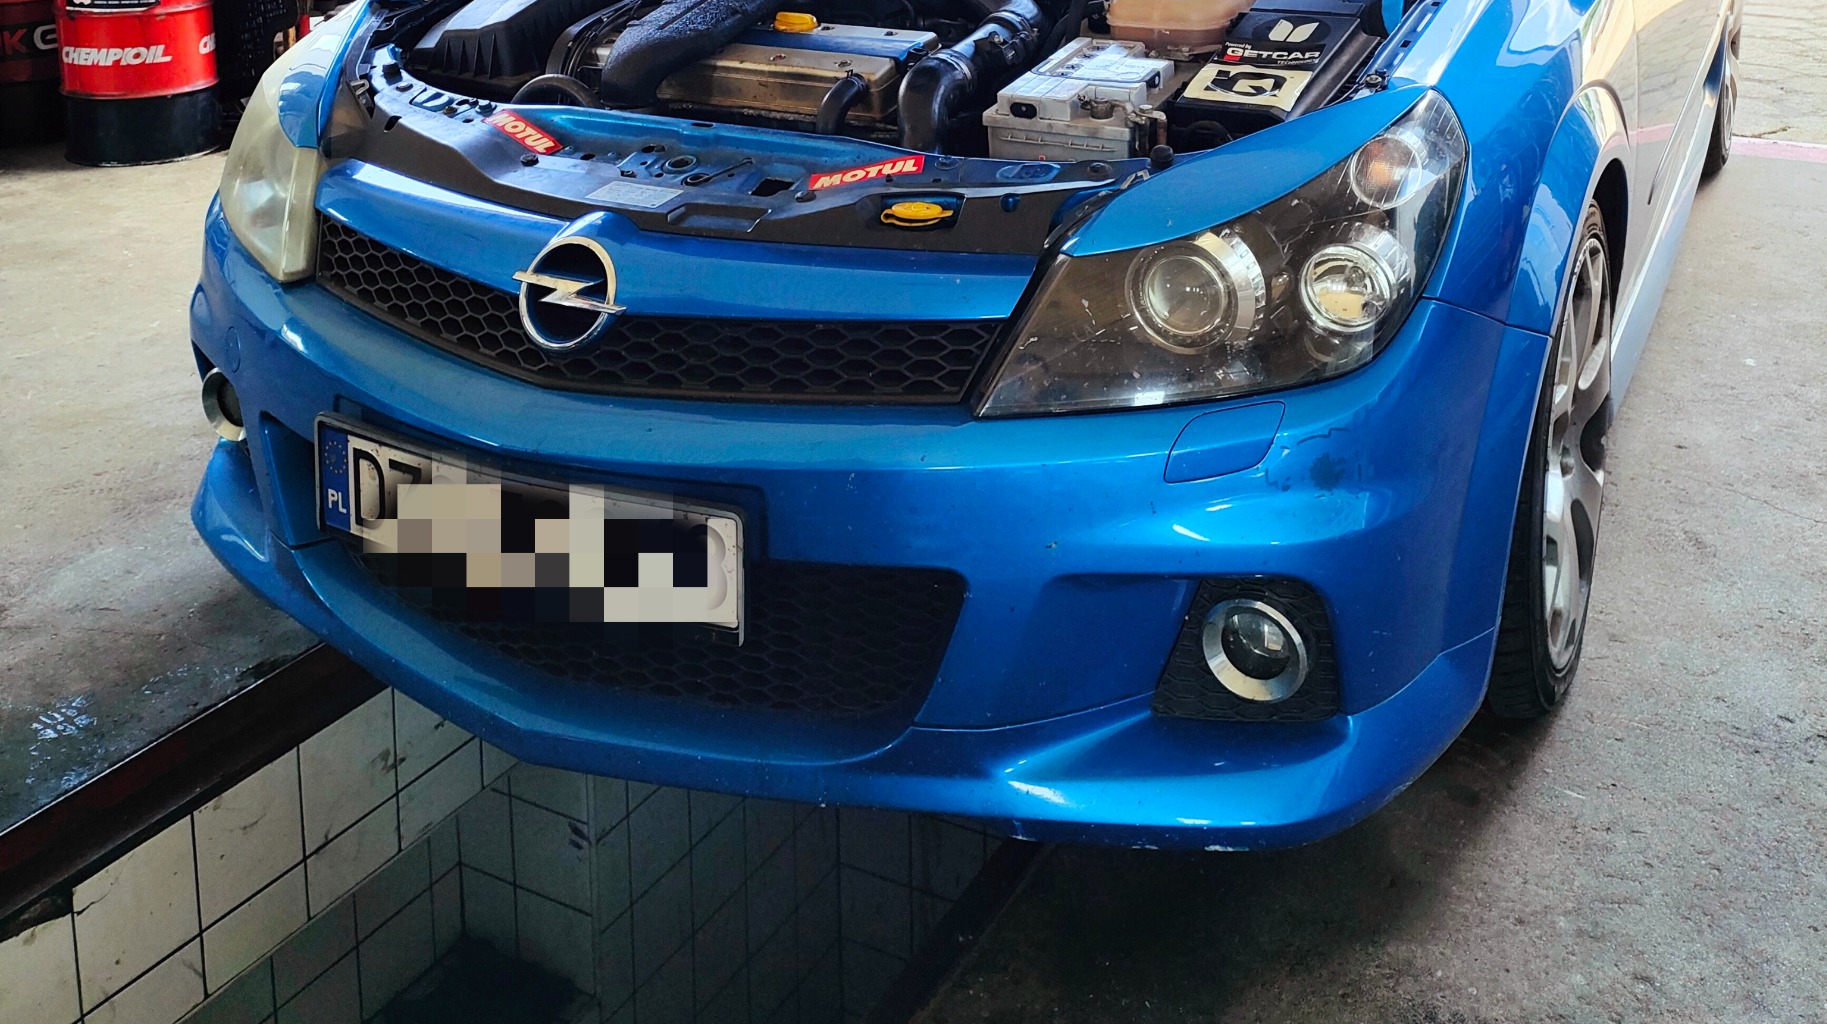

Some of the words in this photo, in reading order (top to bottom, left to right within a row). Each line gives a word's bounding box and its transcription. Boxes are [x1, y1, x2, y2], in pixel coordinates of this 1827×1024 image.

[1226, 48, 1320, 60] GETCAR
[486, 113, 555, 153] MOTUL
[813, 159, 918, 189] MOTUL
[328, 488, 347, 514] PL
